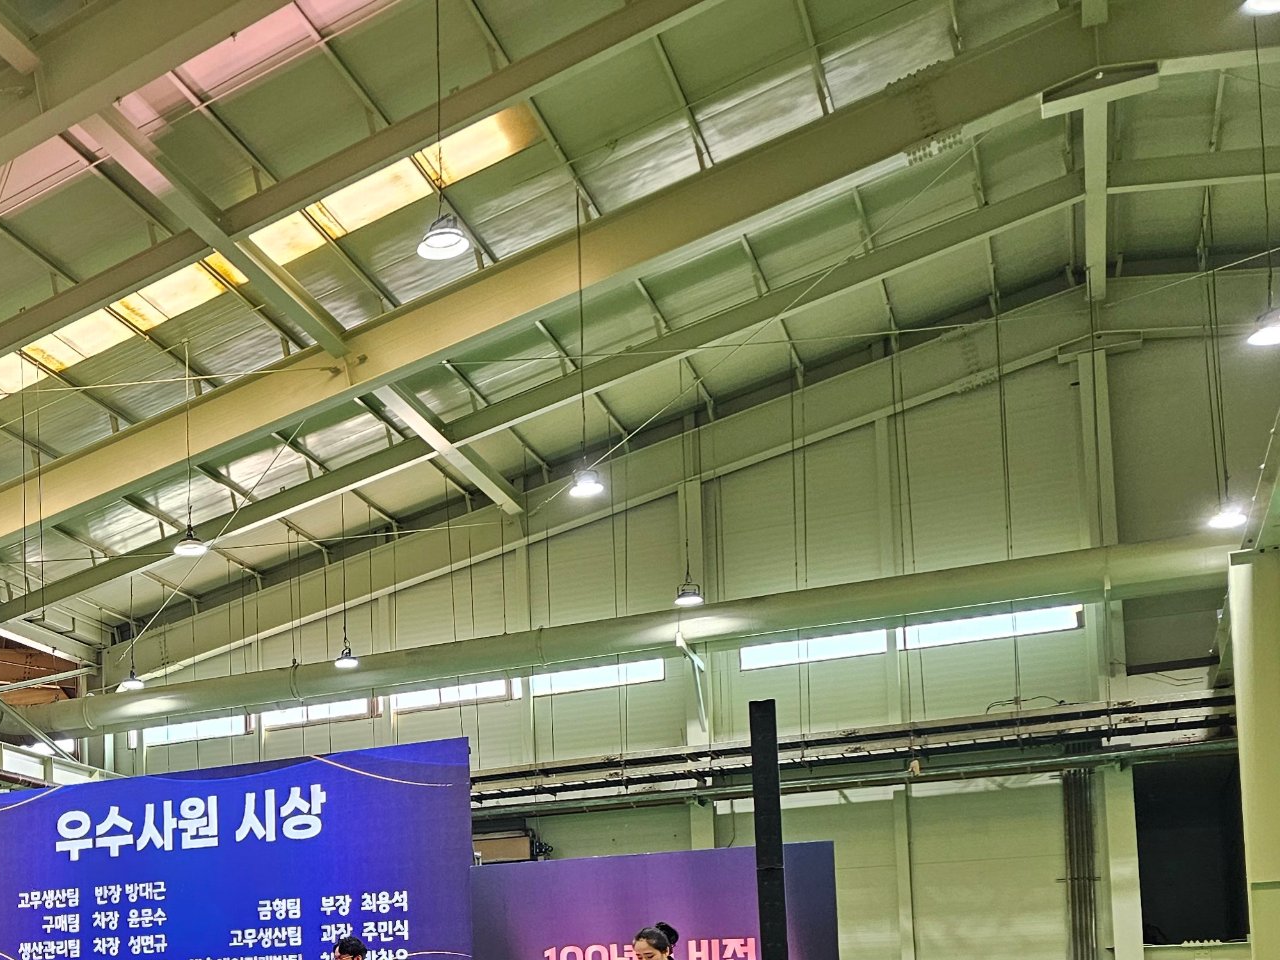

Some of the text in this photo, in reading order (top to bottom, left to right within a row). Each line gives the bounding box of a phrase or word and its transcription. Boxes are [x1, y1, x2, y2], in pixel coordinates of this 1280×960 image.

[55, 783, 327, 862] 우수사원 시상
[18, 881, 166, 909] 고무생산팀 반장 방대근
[257, 890, 408, 920] 금형팀 부장 최용석
[42, 907, 167, 933] 구매팀 차장 윤문수
[229, 926, 302, 948] 고무생산팀
[362, 920, 409, 942] 주민식
[18, 939, 81, 960] 생산관리팀
[93, 937, 120, 956] 차장
